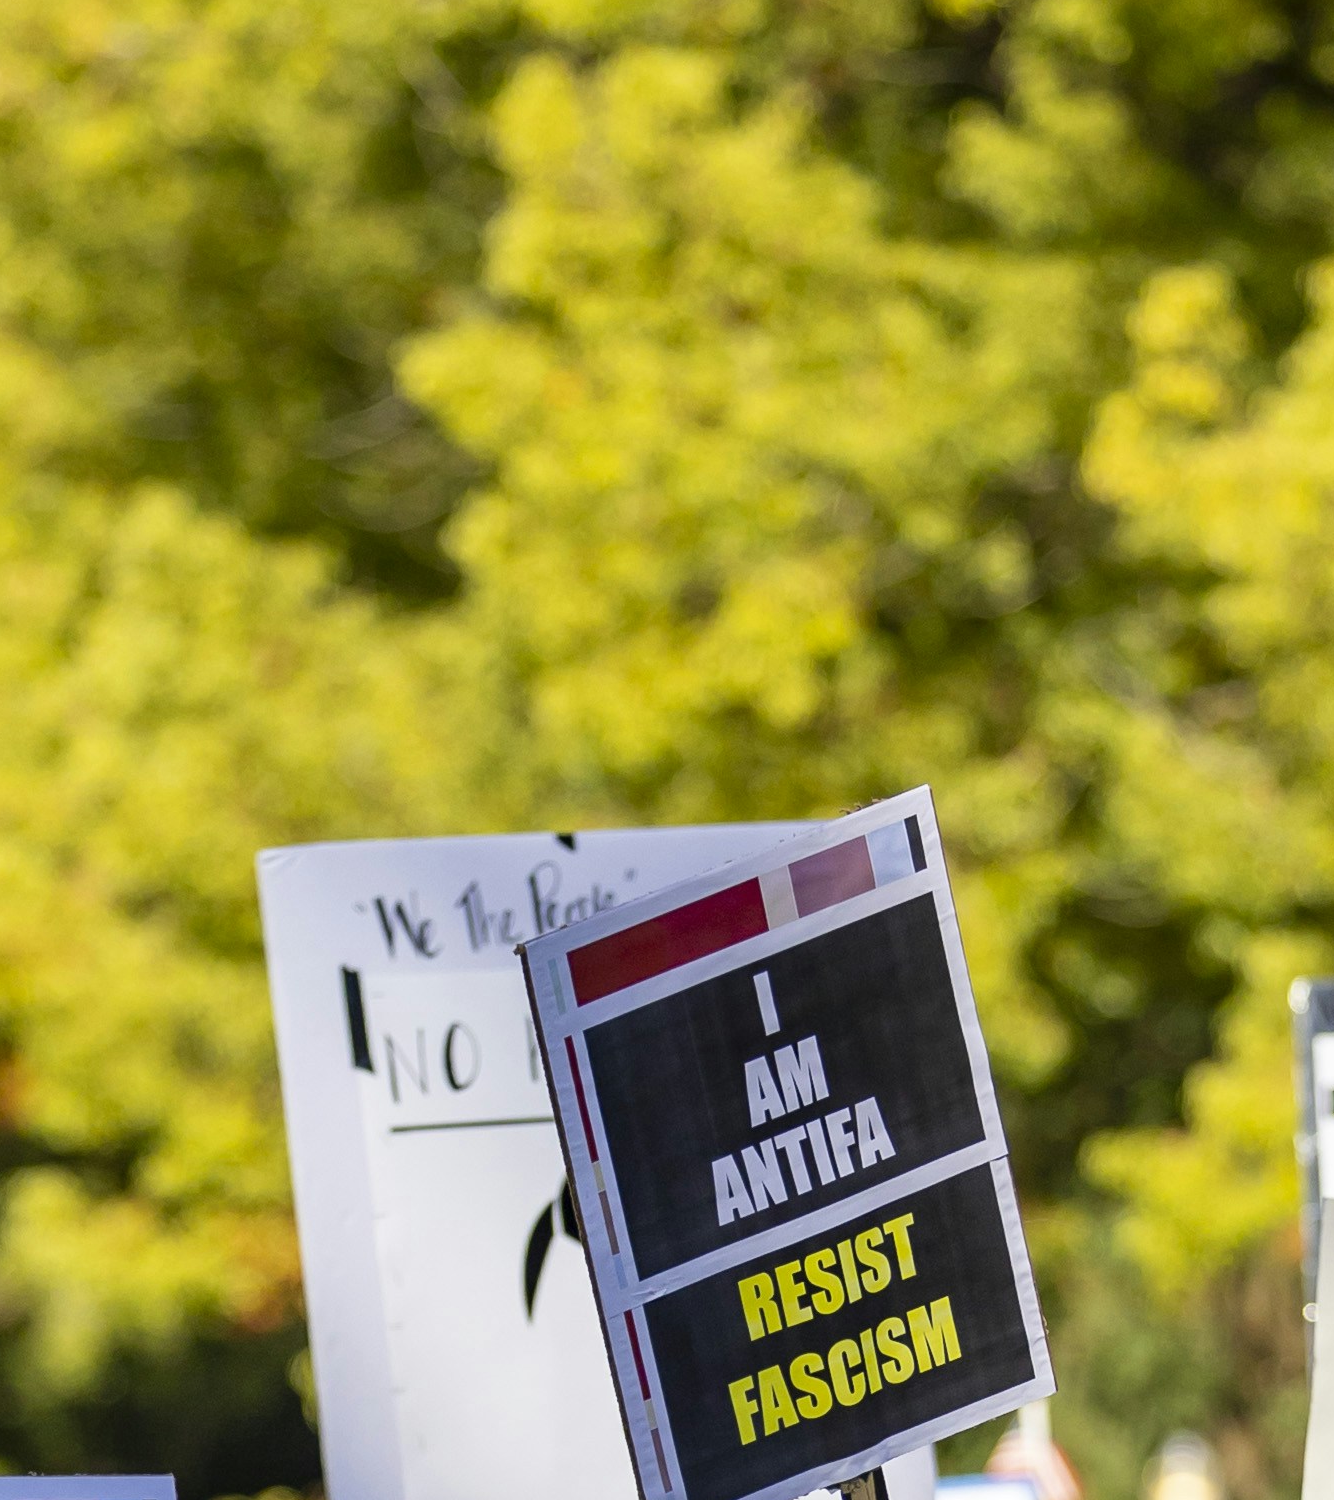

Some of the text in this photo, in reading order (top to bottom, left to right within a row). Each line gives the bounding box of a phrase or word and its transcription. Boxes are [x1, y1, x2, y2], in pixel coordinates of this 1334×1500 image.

[455, 879, 524, 951] The
[753, 970, 780, 1036] I
[384, 1020, 482, 1105] NO
[744, 1034, 829, 1128] AM
[711, 1096, 896, 1226] ANTIFA
[738, 1212, 917, 1341] RESIST
[728, 1295, 962, 1446] FASCISM
